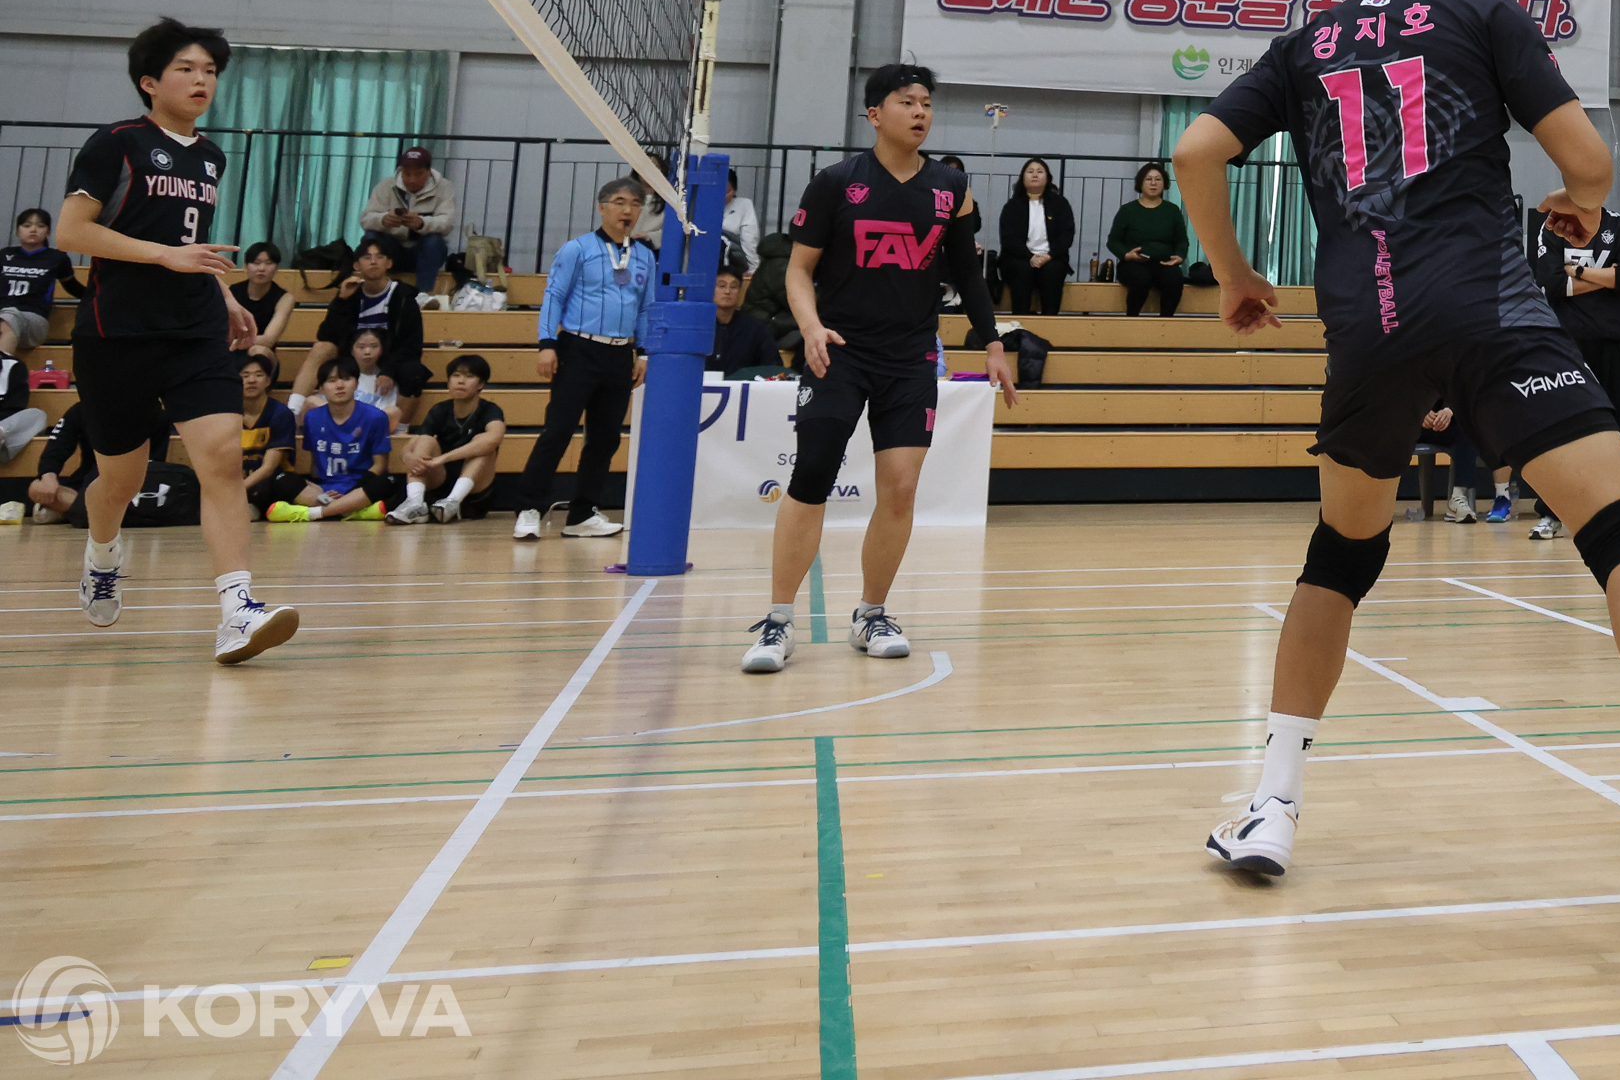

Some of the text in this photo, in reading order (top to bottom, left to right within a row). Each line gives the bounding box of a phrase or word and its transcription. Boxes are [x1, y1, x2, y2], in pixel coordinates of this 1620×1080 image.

[1312, 2, 1435, 59] 강지호
[1218, 58, 1253, 75] 인제
[1318, 55, 1429, 192] 11
[145, 175, 217, 206] YOUNG JON
[932, 188, 954, 211] 10
[181, 206, 199, 244] 9
[853, 219, 944, 270] FAV
[8, 280, 30, 297] 10
